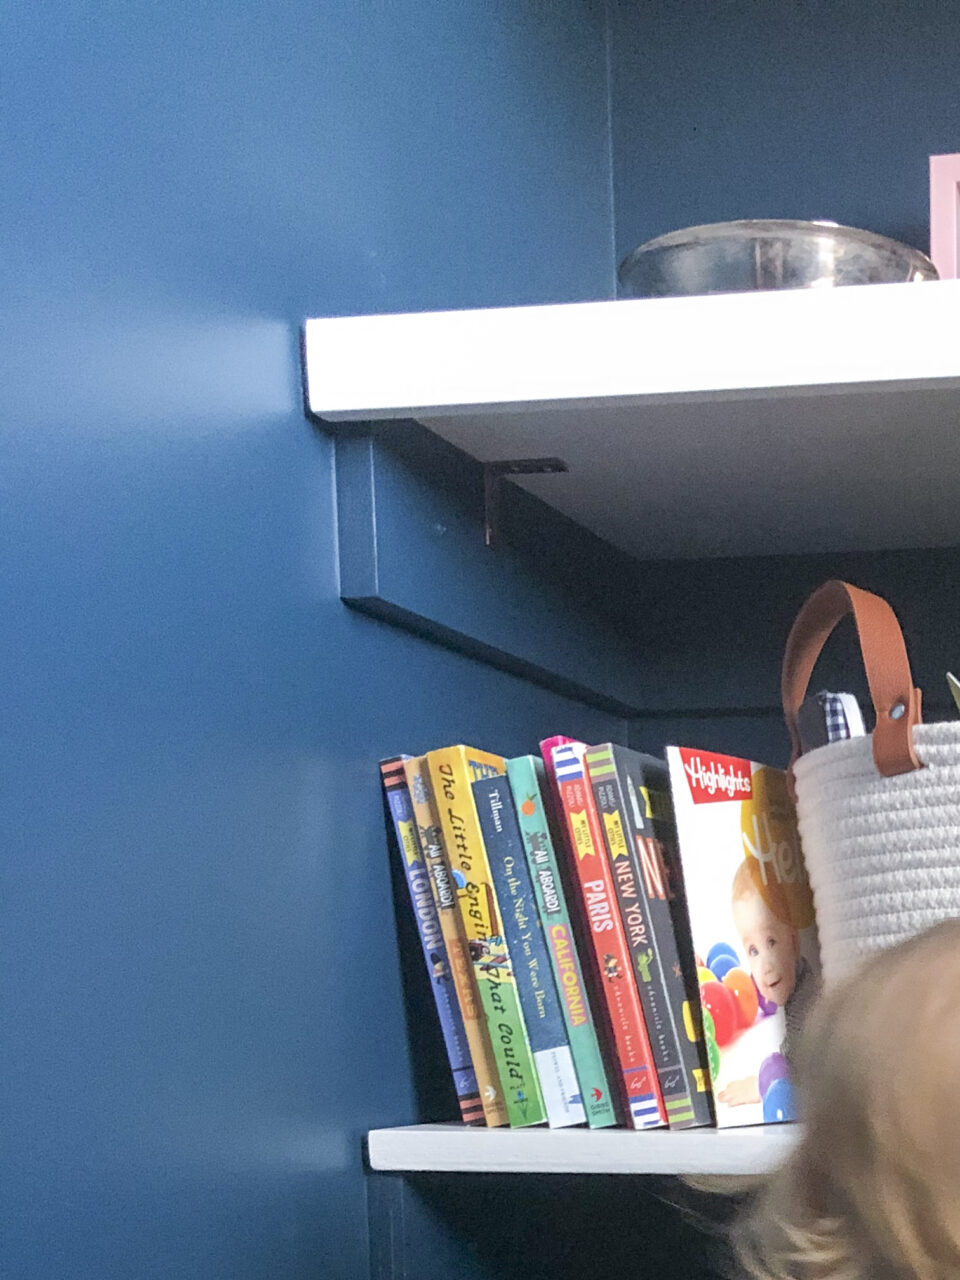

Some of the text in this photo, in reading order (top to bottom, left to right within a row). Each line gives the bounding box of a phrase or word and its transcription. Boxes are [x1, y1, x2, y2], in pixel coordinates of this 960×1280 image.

[489, 789, 503, 832] Tillman
[684, 757, 751, 797] Highlights
[410, 869, 442, 950] LONDON
[428, 844, 454, 907] All ABOARD!
[535, 849, 560, 912] All ABOARD!
[584, 880, 613, 932] PARIS
[616, 861, 648, 947] NEW YORK
[439, 764, 523, 1081] The Little Engine That Could
[503, 857, 546, 1018] On the Night You Were Born
[551, 926, 586, 1025] CALIFORNIA
